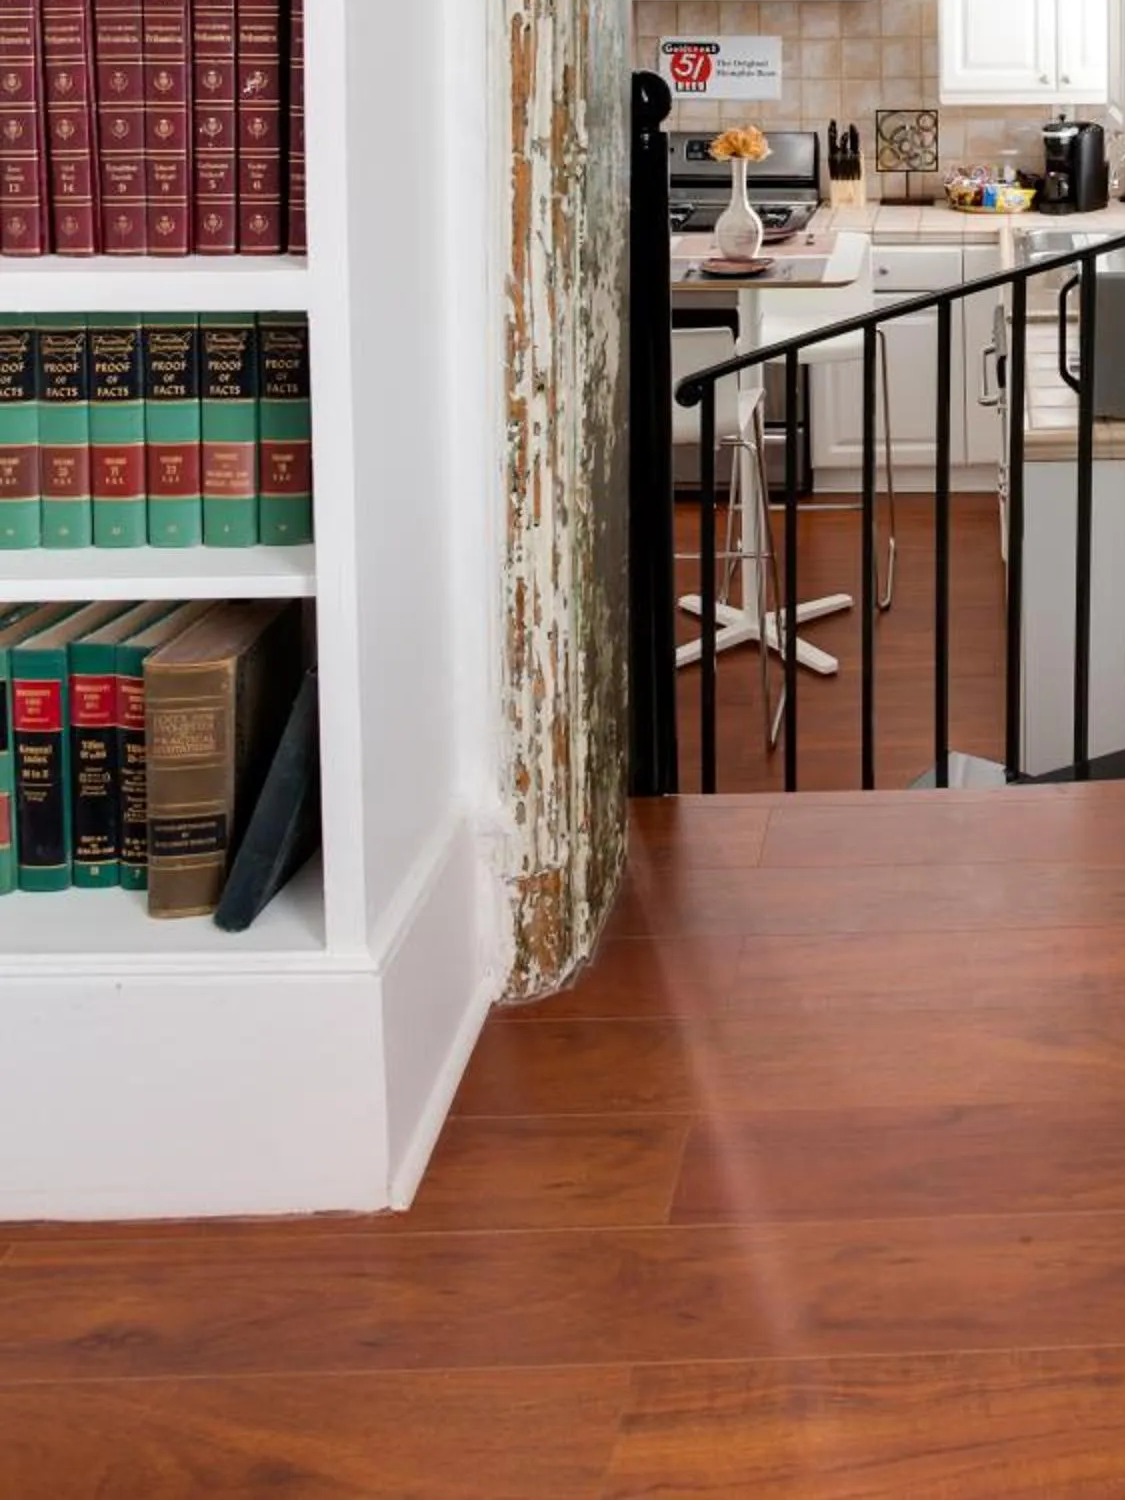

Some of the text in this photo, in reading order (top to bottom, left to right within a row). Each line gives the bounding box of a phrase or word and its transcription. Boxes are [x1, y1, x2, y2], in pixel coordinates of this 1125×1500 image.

[44, 363, 80, 373] PROOF
[95, 361, 132, 373] PROOF
[151, 361, 187, 371] PROOF
[208, 360, 242, 371] PROOF
[46, 387, 79, 397] FACTS
[97, 386, 129, 397] FACTS
[153, 385, 186, 396] FACTS
[209, 385, 241, 395] FACTS
